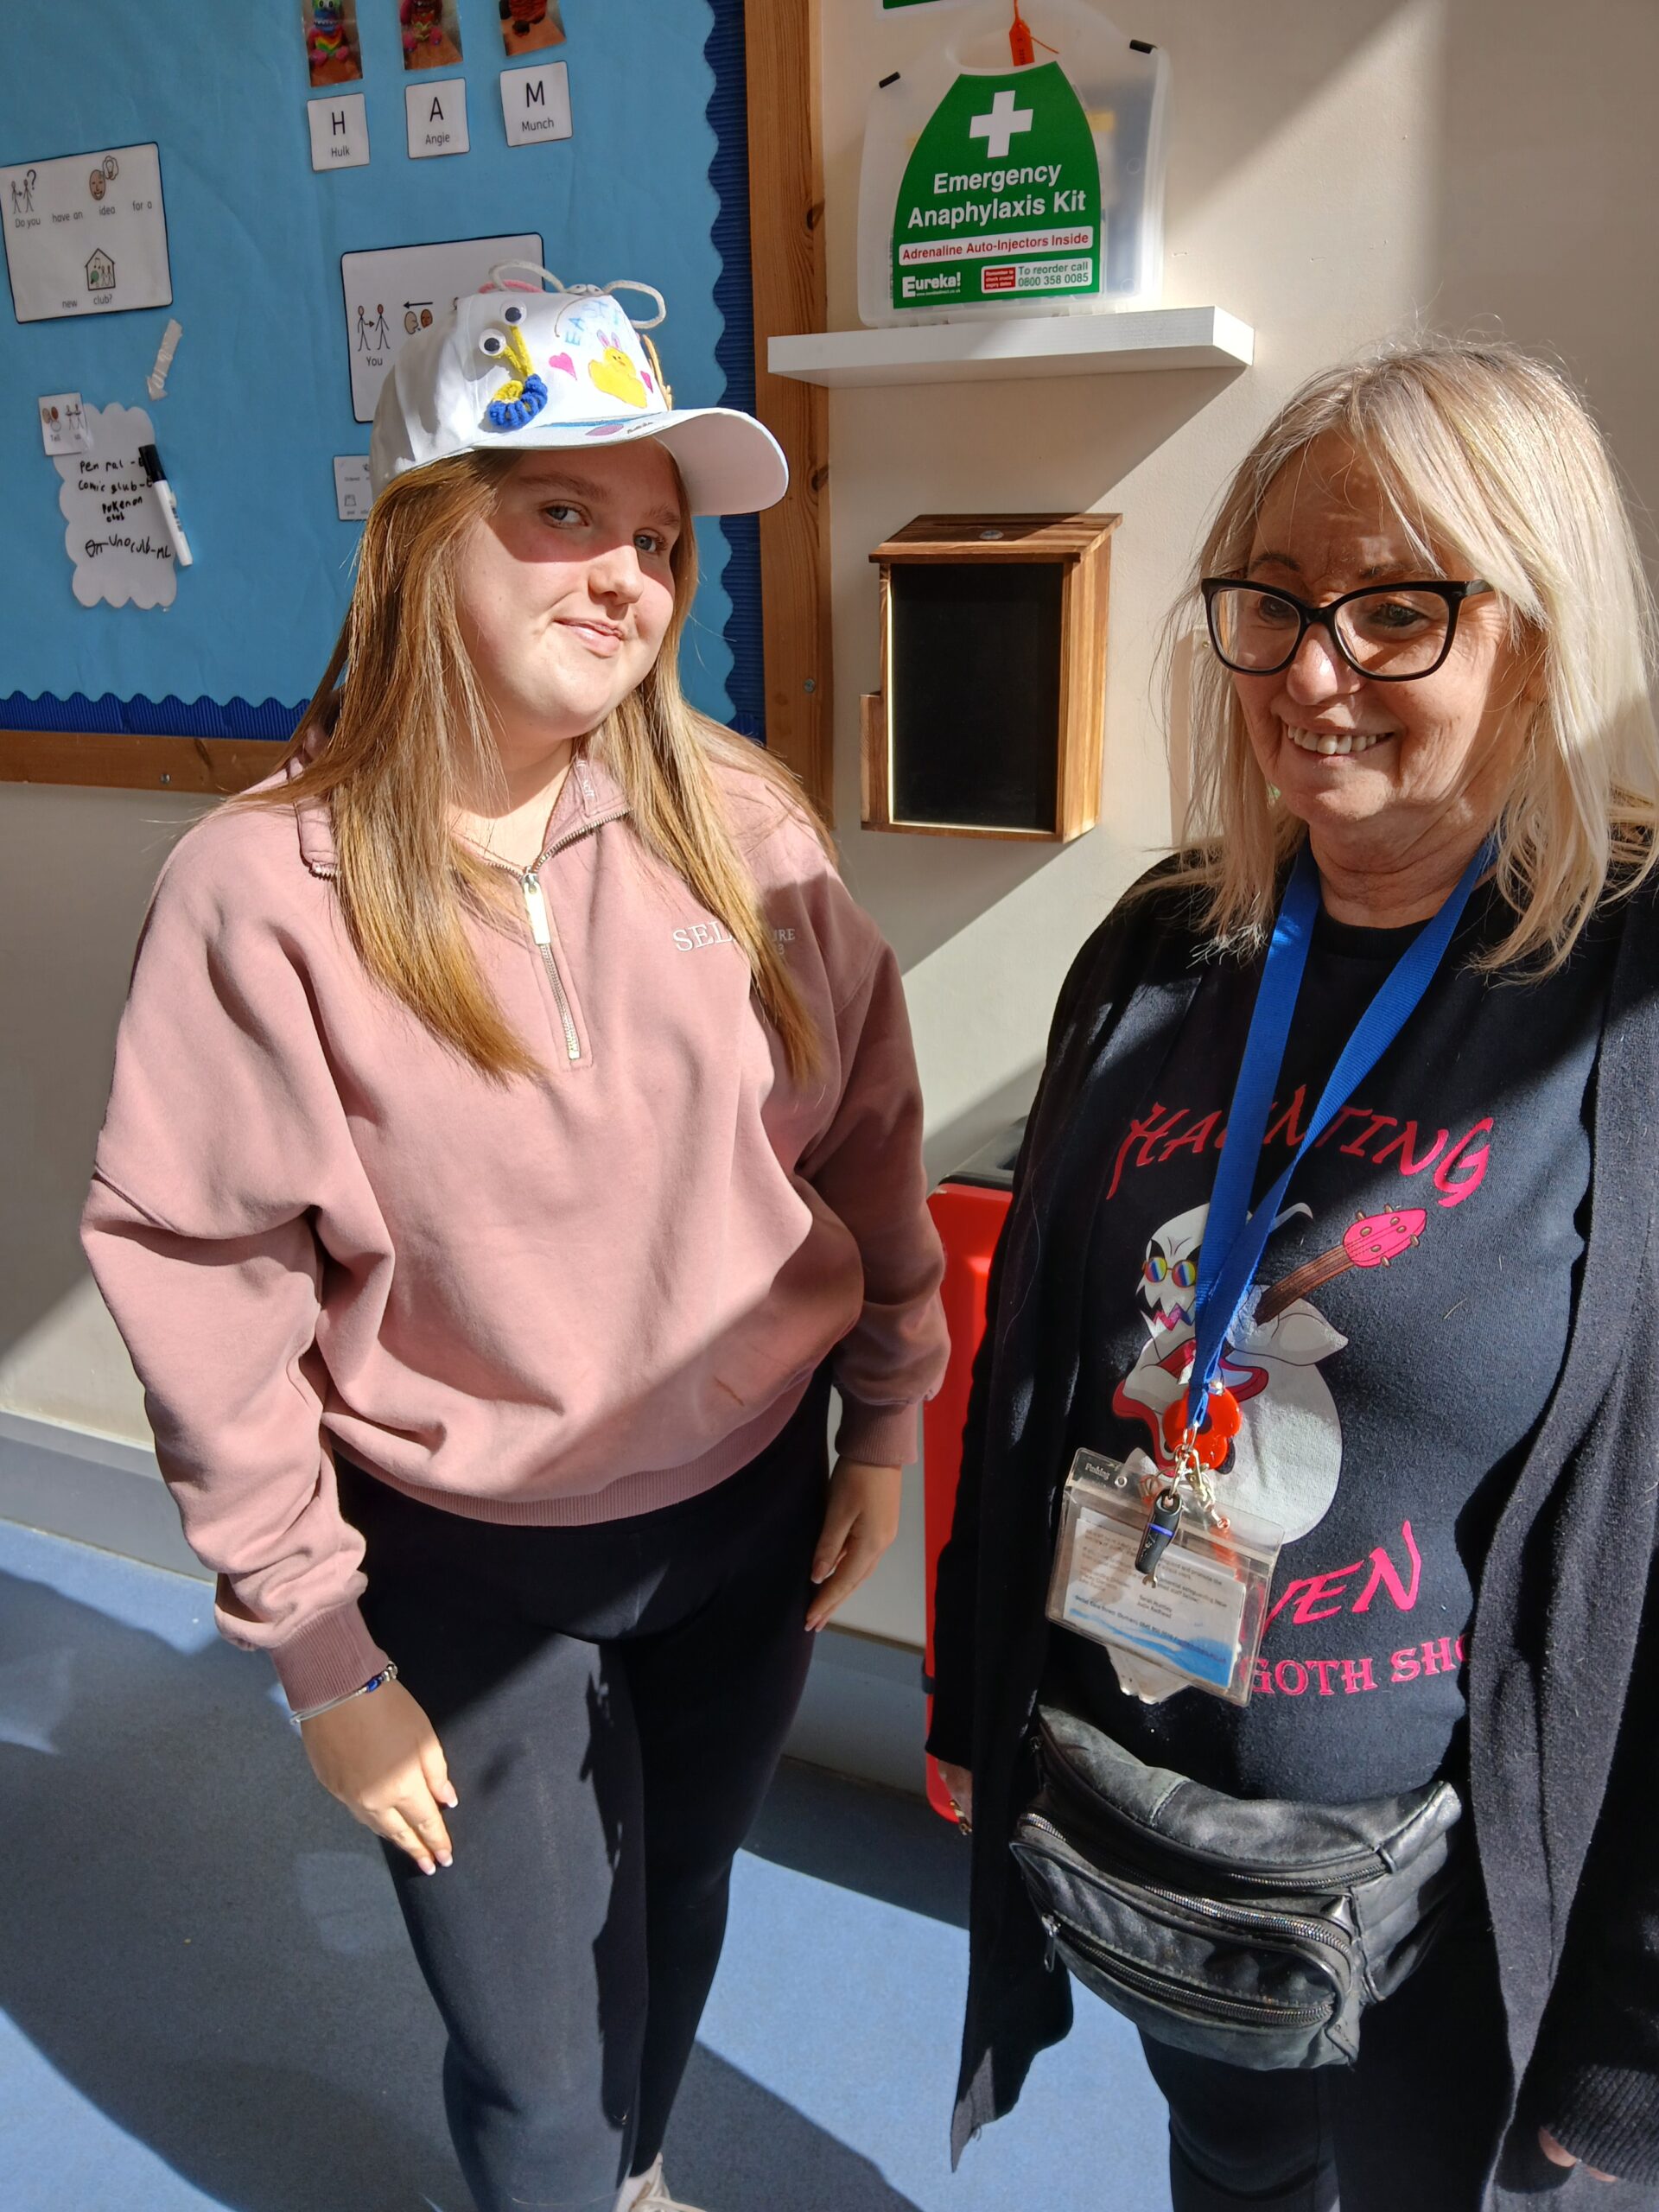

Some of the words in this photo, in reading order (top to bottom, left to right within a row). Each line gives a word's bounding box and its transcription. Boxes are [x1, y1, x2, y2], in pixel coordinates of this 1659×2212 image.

[526, 80, 545, 108] M
[429, 97, 444, 122] A
[332, 111, 346, 136] H
[522, 118, 555, 132] Munch
[331, 146, 350, 157] Hulk
[425, 133, 450, 146] Angie
[933, 164, 1062, 194] Emergency
[15, 218, 26, 228] Do
[27, 218, 41, 229] you
[52, 213, 70, 223] have
[73, 211, 83, 219] an
[99, 206, 116, 216] idea
[132, 200, 143, 211] for
[907, 194, 1046, 230] Anaphylaxis
[1053, 189, 1087, 213] Kit
[902, 245, 963, 260] Adrenaline
[967, 236, 1049, 253] Auto-Injectors
[1052, 232, 1089, 246] Inside
[1018, 266, 1031, 276] To
[1033, 264, 1069, 275] reorder
[1071, 261, 1089, 271] call
[1018, 276, 1041, 287] 0800
[1044, 275, 1062, 286] 358
[1064, 272, 1089, 284] 0085
[902, 271, 961, 298] Eureka!
[62, 300, 78, 308] new
[93, 294, 112, 305] club?
[365, 356, 383, 366] You
[672, 920, 734, 952] SEL
[774, 928, 796, 941] RE
[1106, 1084, 1494, 1208] HANTING
[1239, 1655, 1378, 1696] GOTH
